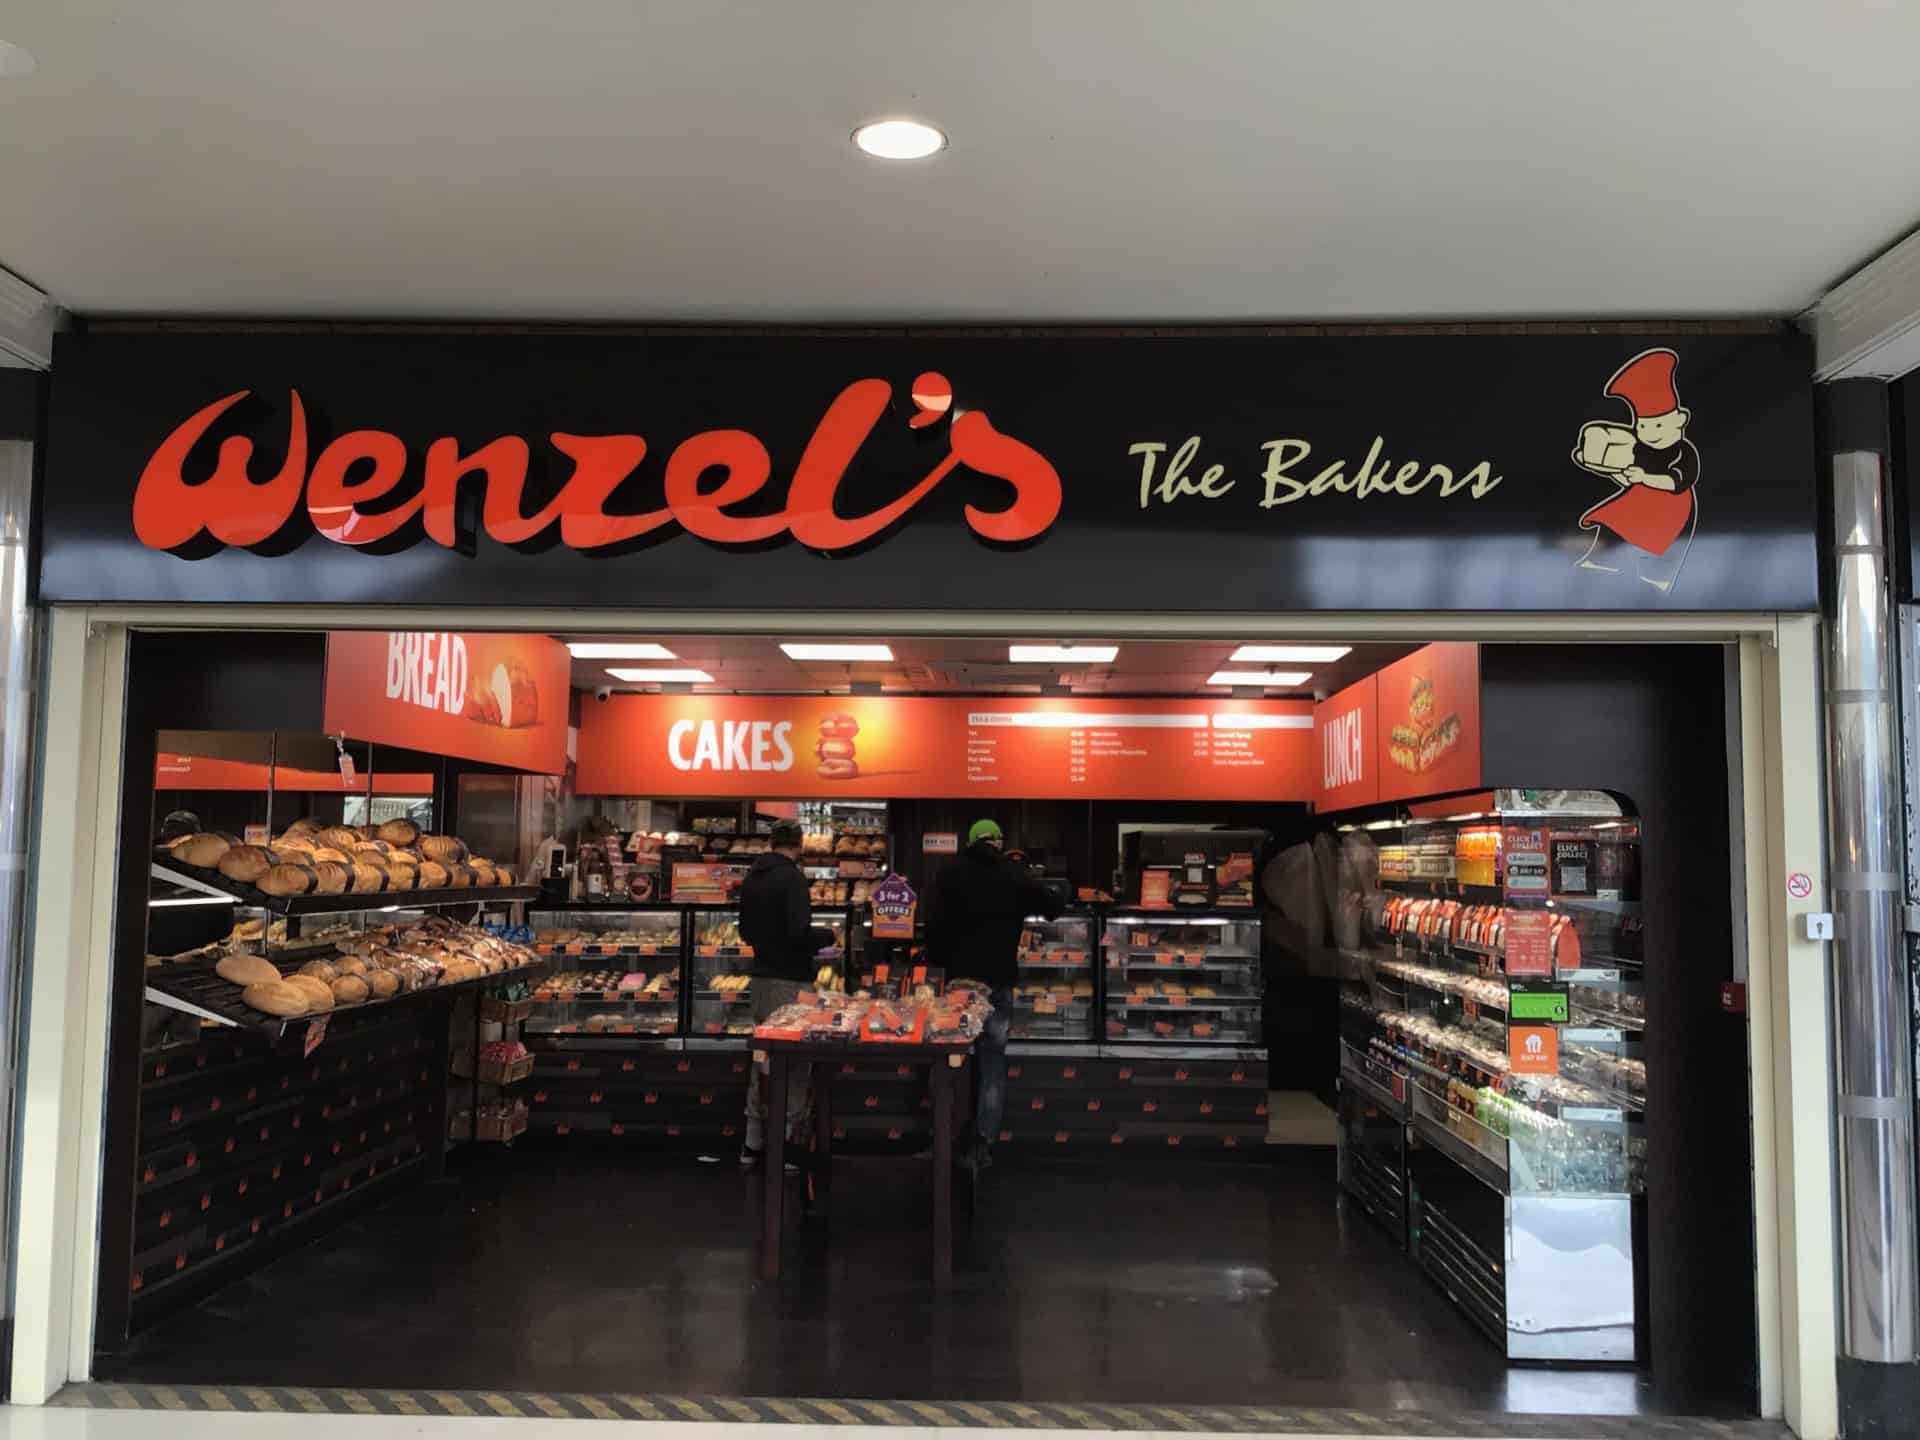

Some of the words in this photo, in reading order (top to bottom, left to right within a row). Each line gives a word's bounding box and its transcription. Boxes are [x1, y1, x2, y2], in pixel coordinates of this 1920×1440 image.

[133, 371, 1062, 551] Wenzel's
[1128, 436, 1236, 508] The
[1259, 436, 1503, 509] Bakers
[386, 632, 467, 715] BREAD
[667, 719, 794, 771] CAKES
[1324, 707, 1361, 791] LUNCH
